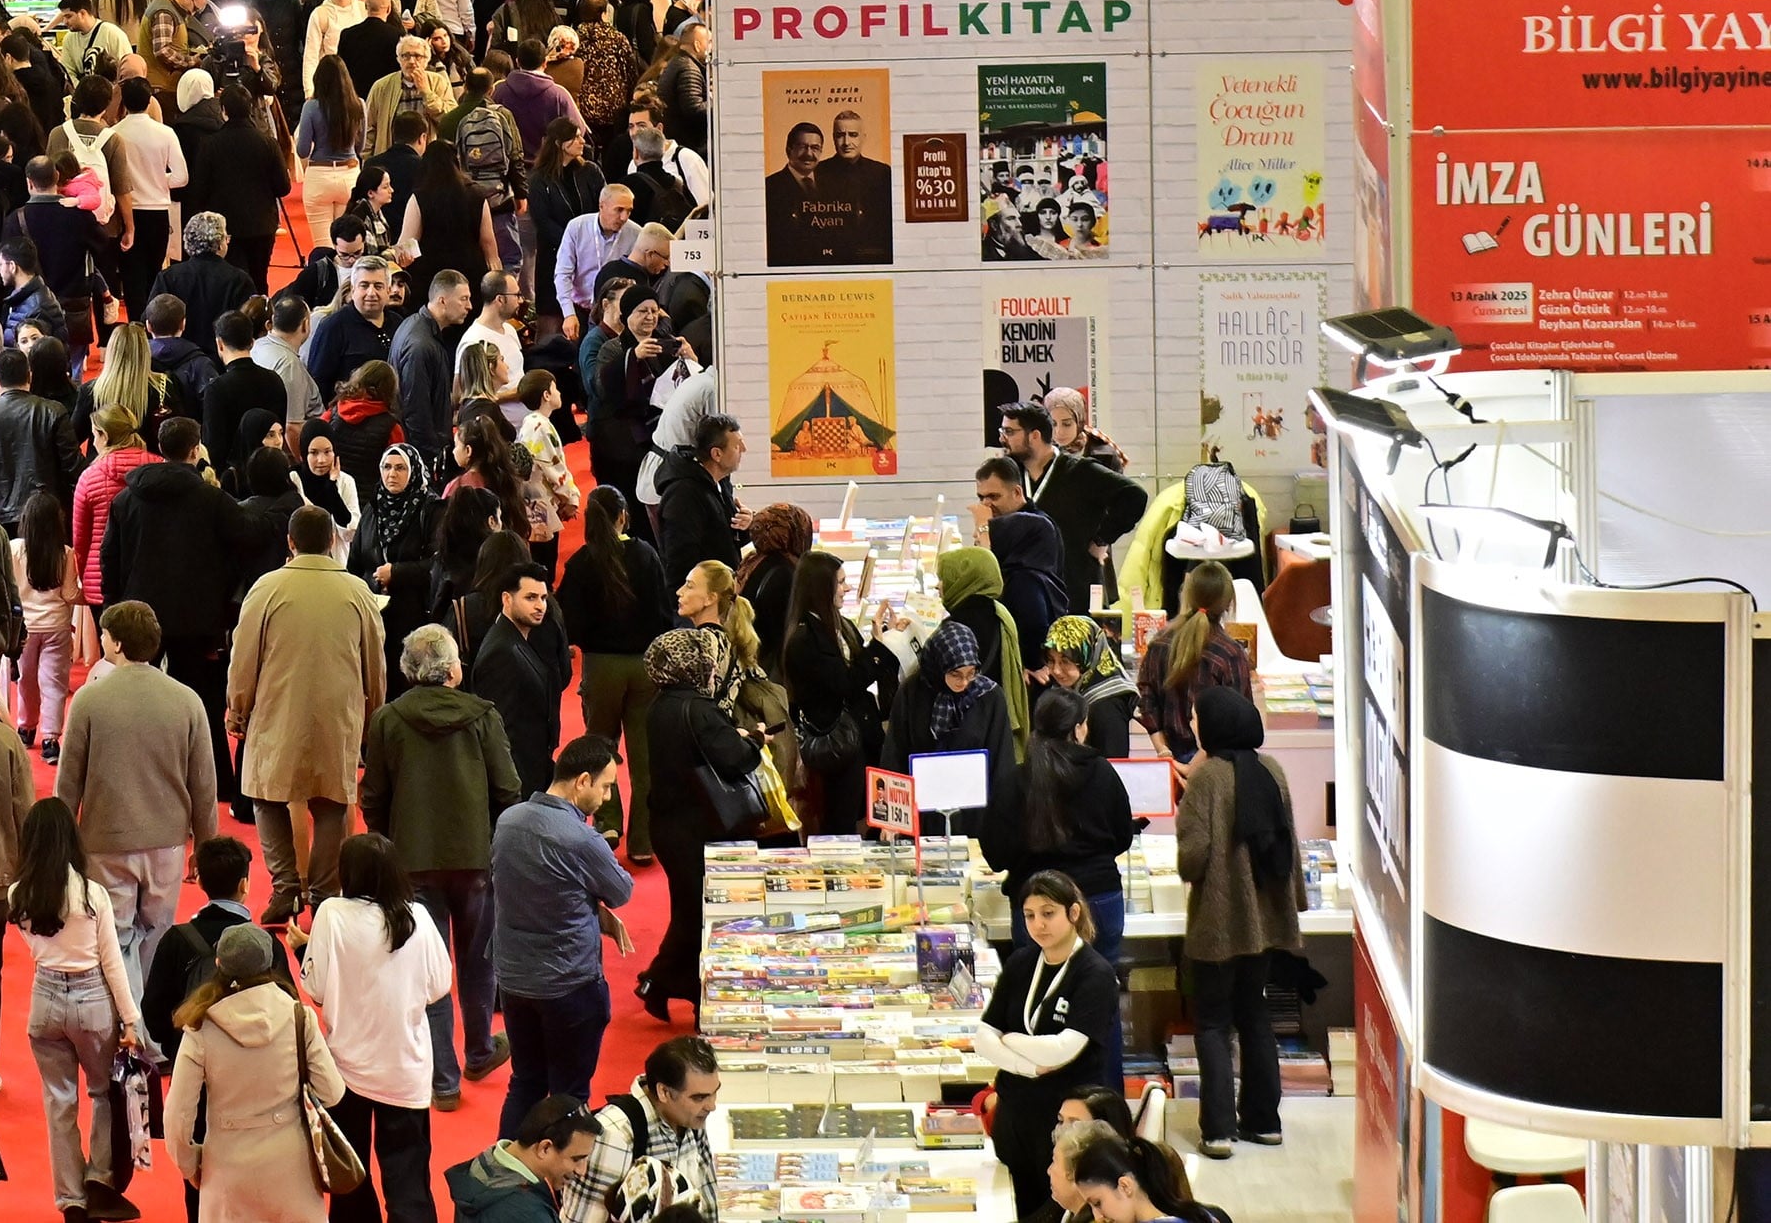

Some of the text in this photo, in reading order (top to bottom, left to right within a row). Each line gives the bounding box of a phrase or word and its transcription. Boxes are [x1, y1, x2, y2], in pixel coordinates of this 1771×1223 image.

[1522, 3, 1667, 54] BİLGİ
[985, 75, 1054, 86] YENİ HAYATIN
[1221, 74, 1298, 95] Yetenekli
[986, 86, 1065, 96] YENİ KADINLARI
[1209, 94, 1305, 127] Çocuğun
[1221, 124, 1295, 147] Dramı
[923, 151, 946, 162] Profil
[1259, 158, 1296, 171] Miller
[917, 165, 951, 178] Kitap'ta
[1435, 151, 1546, 206] İMZA
[916, 179, 955, 195] %30
[802, 201, 852, 213] Fabrika
[915, 199, 957, 208] İNDİRİM
[1522, 201, 1714, 258] GÜNLERİ
[684, 250, 702, 260] 753
[782, 293, 875, 302] BERNARD LEWIS
[1466, 291, 1498, 301] Aralık
[1501, 291, 1527, 301] 2025
[1539, 287, 1614, 300] Zehra Ünüvar
[1001, 297, 1071, 316] FOUCAULT
[1539, 302, 1610, 316] Güzin Öztürk
[1002, 319, 1056, 341] KENDİNİ
[1539, 318, 1642, 331] Reyhan Karaarslan
[1002, 342, 1054, 363] BİLMEK
[889, 789, 910, 806] NUTUK
